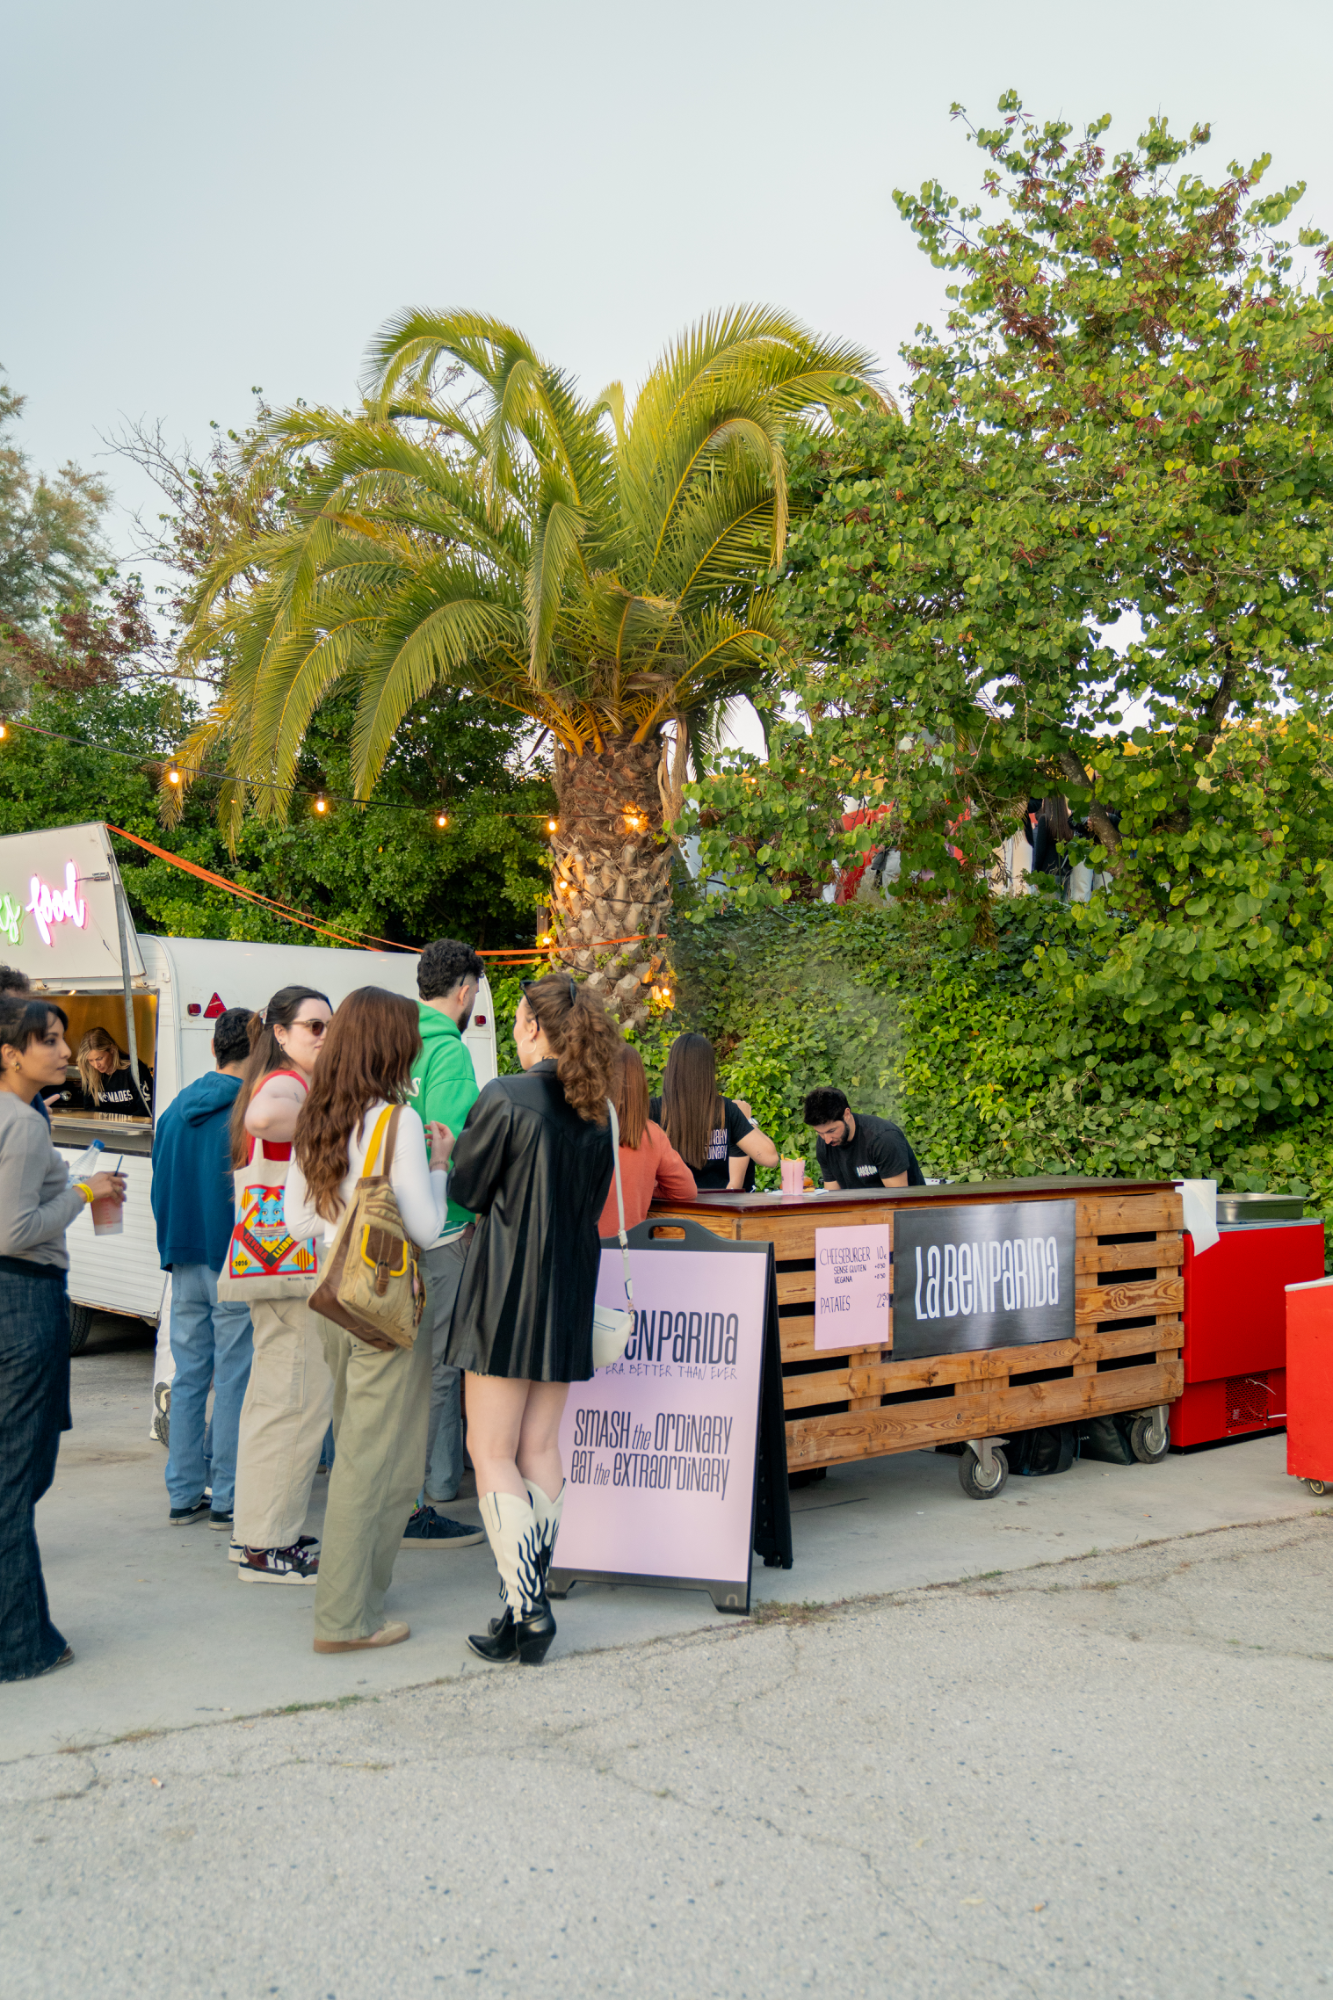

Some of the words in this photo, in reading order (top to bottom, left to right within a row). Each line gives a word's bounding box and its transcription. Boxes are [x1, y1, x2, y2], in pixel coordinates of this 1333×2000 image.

[25, 862, 84, 945] food
[244, 1232, 269, 1260] DEVORA
[272, 1235, 294, 1259] LLIBR
[820, 1247, 871, 1266] CHEESEBURGER
[820, 1295, 851, 1314] PATATES
[629, 1363, 673, 1378] BETTER
[677, 1365, 707, 1380] THAN
[711, 1367, 738, 1380] EVER
[631, 1423, 652, 1450] the
[593, 1462, 611, 1486] the
